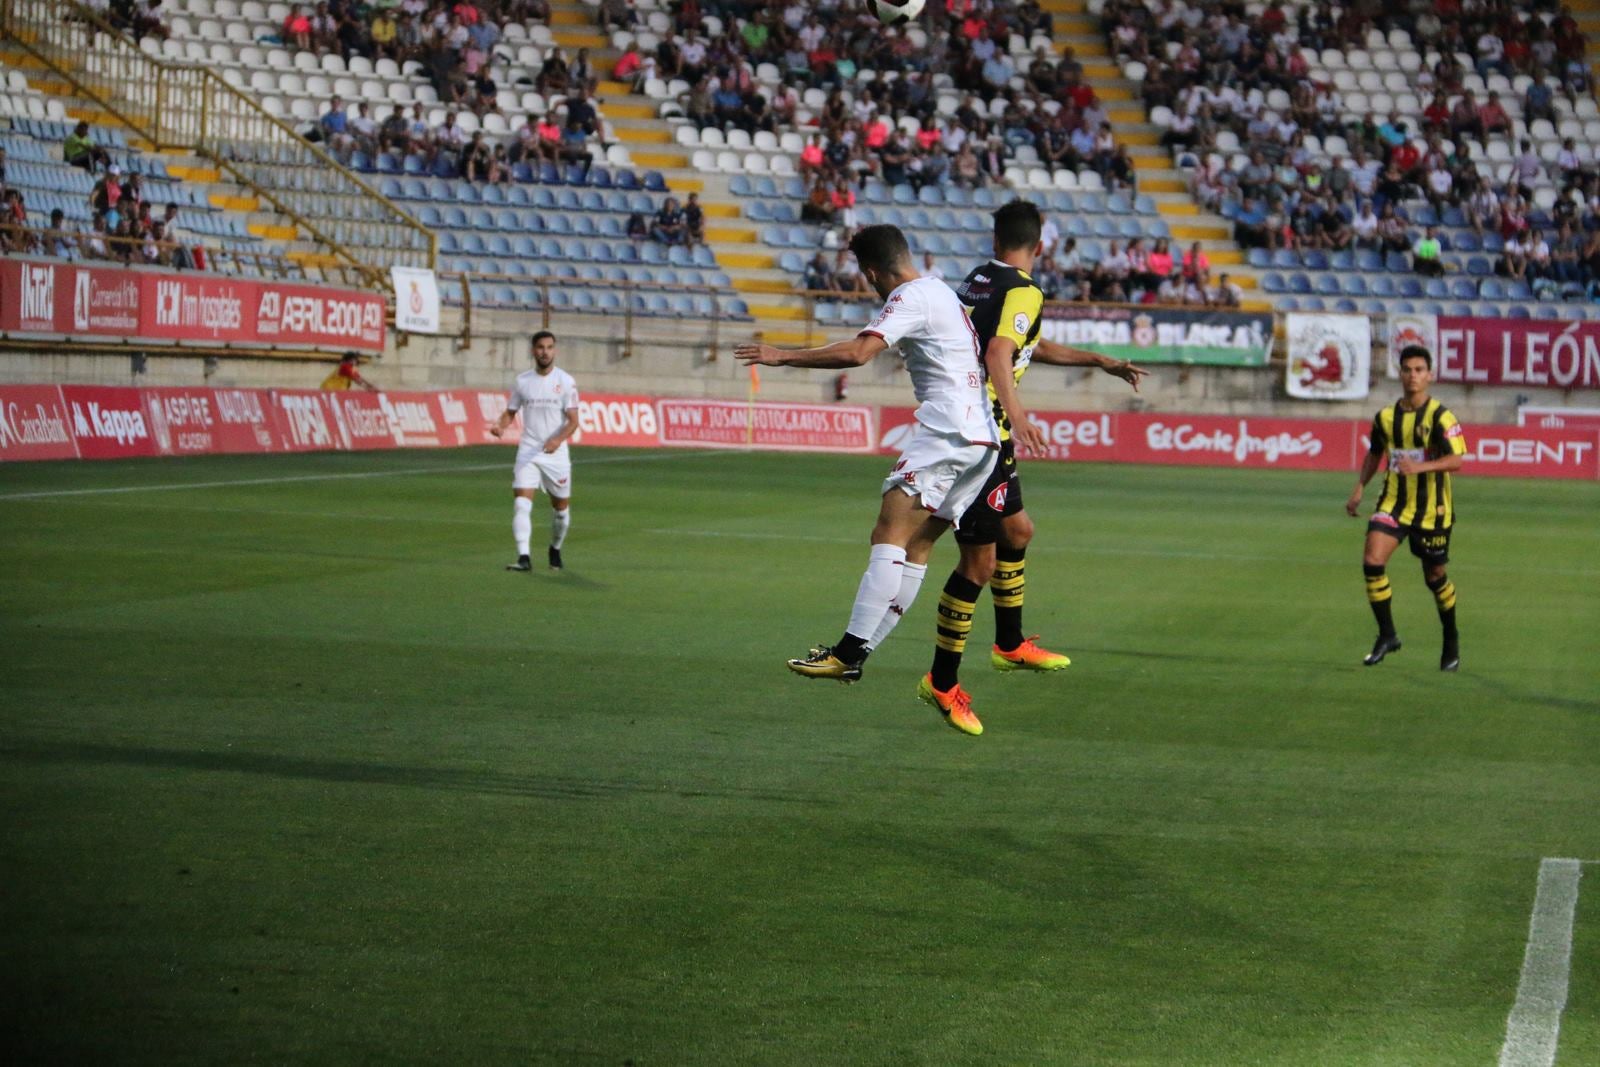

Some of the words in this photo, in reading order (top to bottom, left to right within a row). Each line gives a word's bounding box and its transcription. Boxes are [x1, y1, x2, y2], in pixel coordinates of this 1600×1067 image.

[1439, 329, 1488, 382] EL
[87, 402, 148, 445] Kappa
[164, 393, 213, 429] ASPIRE
